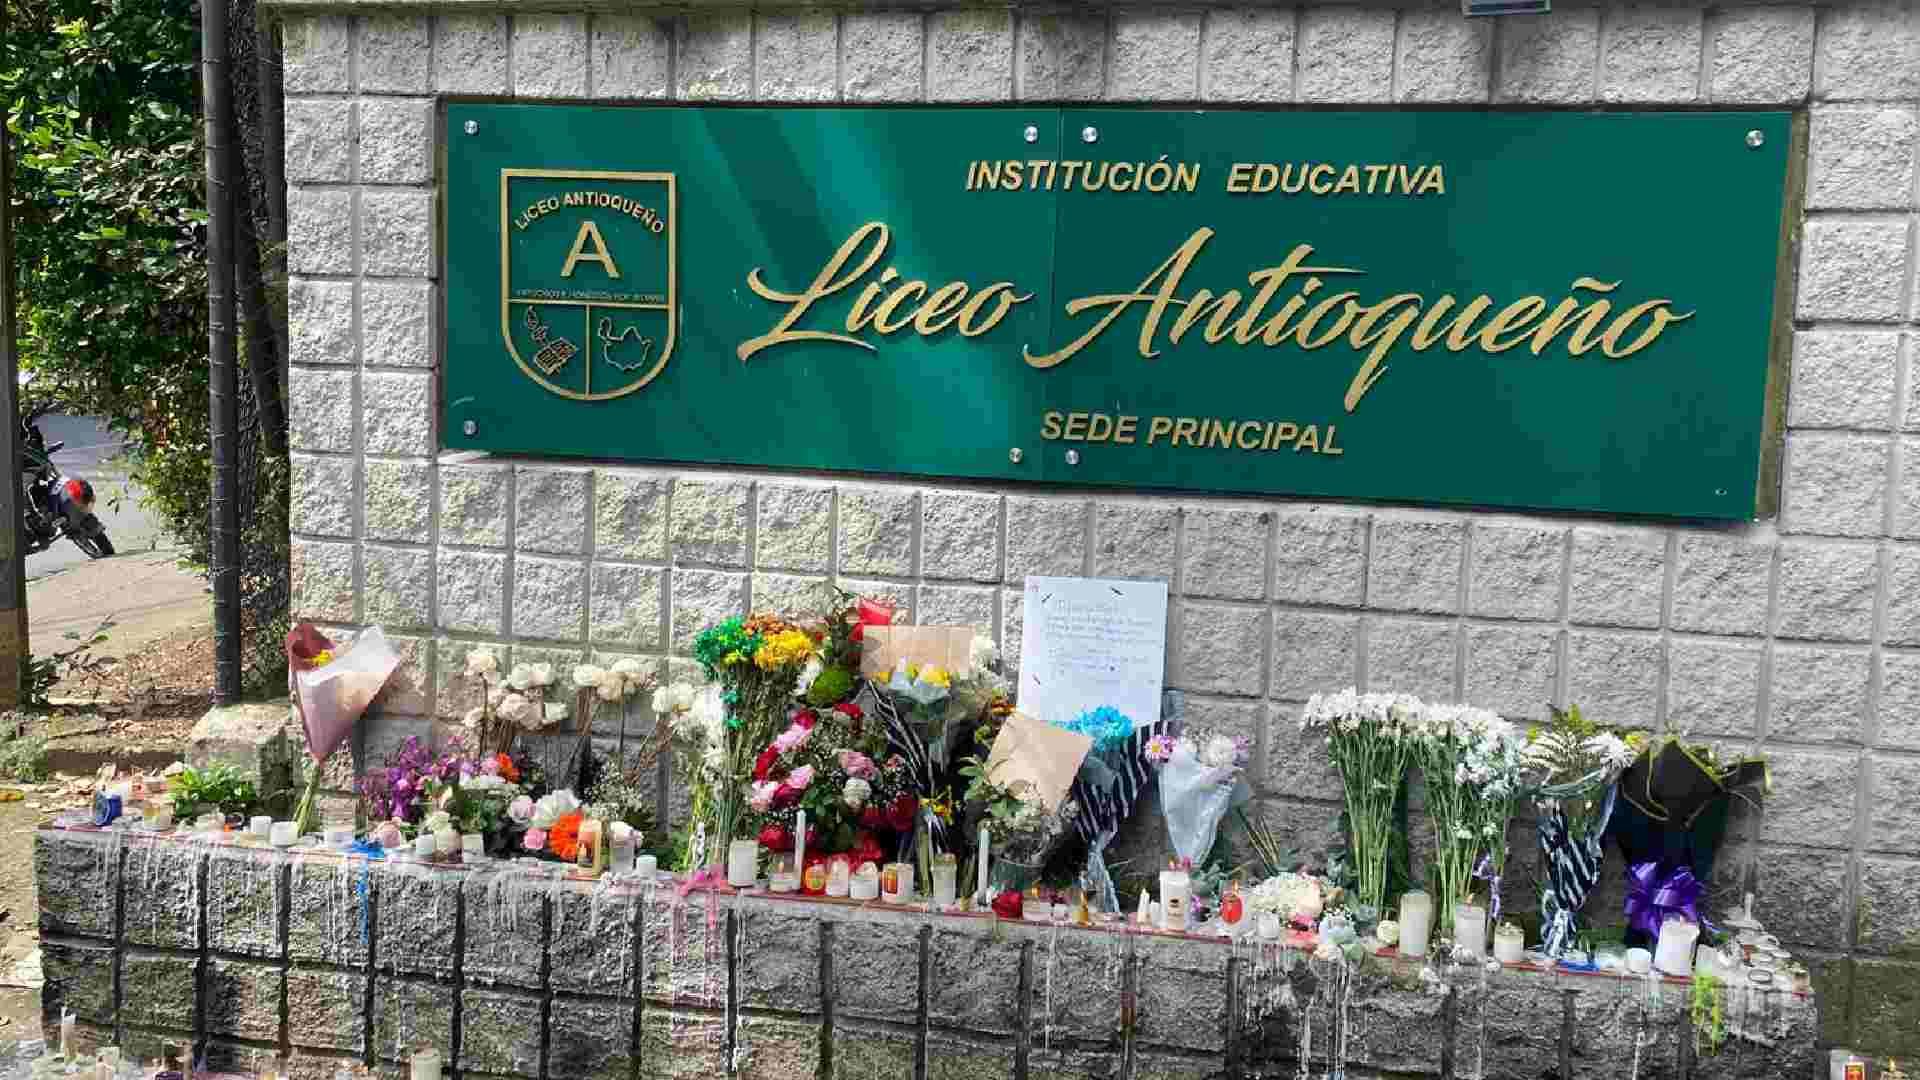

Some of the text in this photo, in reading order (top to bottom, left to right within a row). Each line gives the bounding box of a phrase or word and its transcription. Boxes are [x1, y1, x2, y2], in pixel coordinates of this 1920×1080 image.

[965, 155, 1446, 195] INSTITUCIÓN EDUCATIVA
[515, 191, 664, 233] LICEO ANTIOQUEÑO
[560, 220, 620, 279] A
[737, 221, 1695, 413] Liceo Antioqueño
[1041, 411, 1344, 455] SEDE PRINCIPAL
